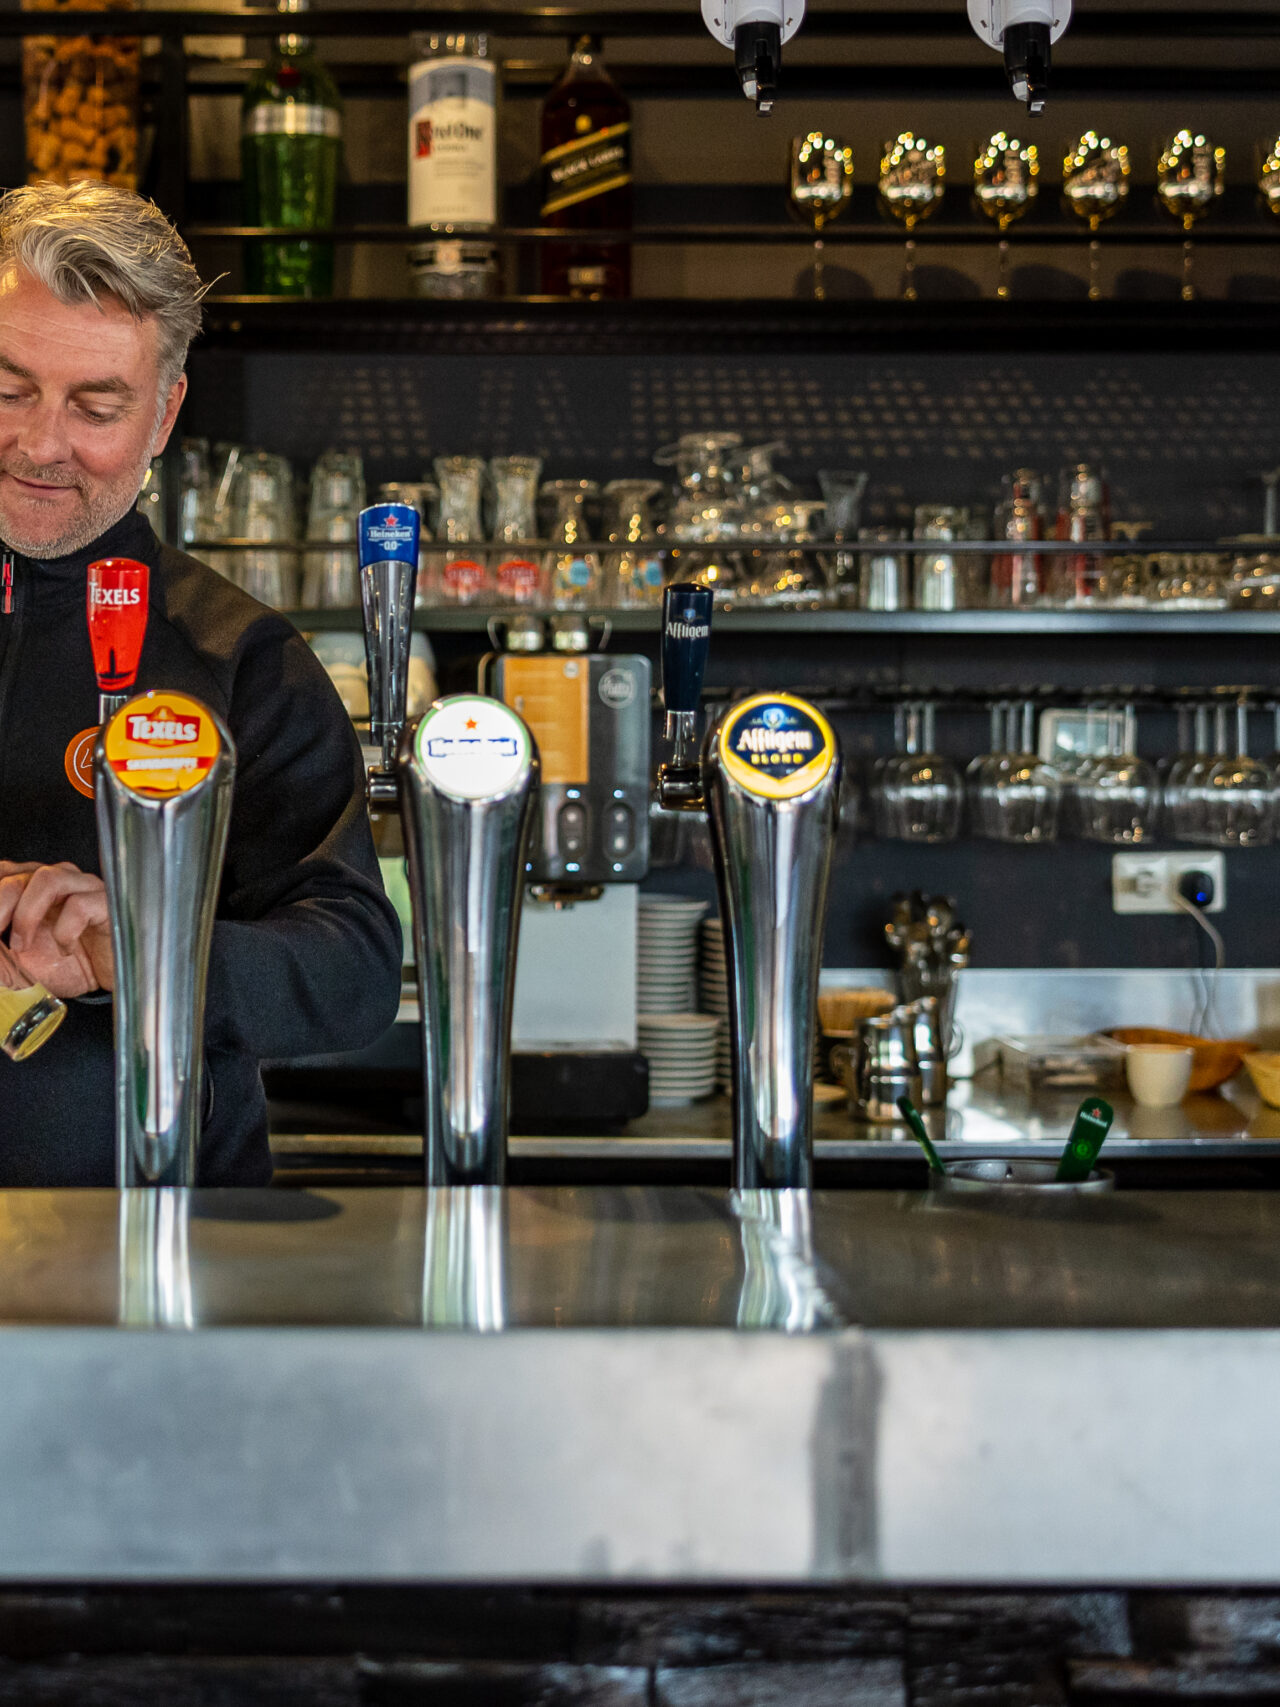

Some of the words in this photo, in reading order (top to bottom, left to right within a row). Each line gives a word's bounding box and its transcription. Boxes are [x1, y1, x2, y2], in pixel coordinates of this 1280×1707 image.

[370, 529, 411, 538] Heineken
[665, 621, 709, 642] Affligem
[736, 728, 813, 753] Affligem
[750, 752, 804, 765] BLOND
